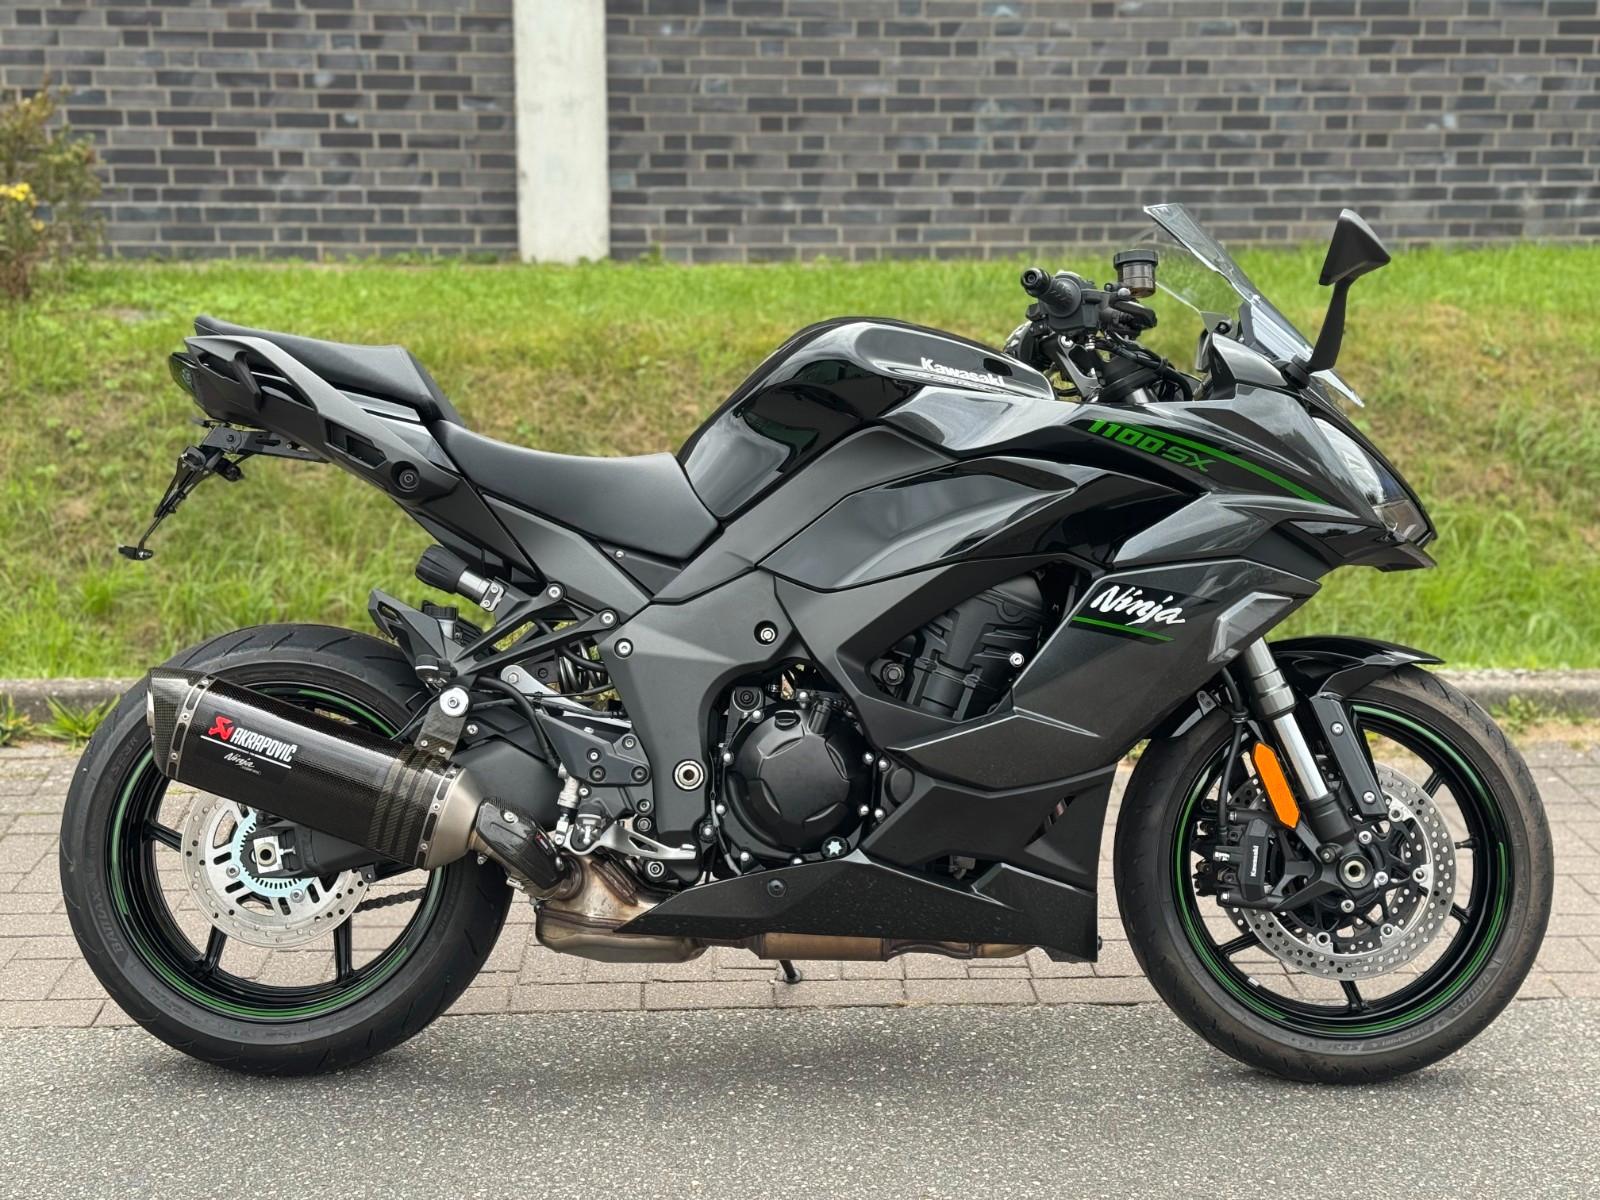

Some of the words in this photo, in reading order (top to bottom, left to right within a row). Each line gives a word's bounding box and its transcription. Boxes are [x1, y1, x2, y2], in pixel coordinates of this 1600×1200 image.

[921, 357, 1005, 387] Kawasaki
[1090, 585, 1186, 626] Ninja
[223, 752, 255, 768] Ninja
